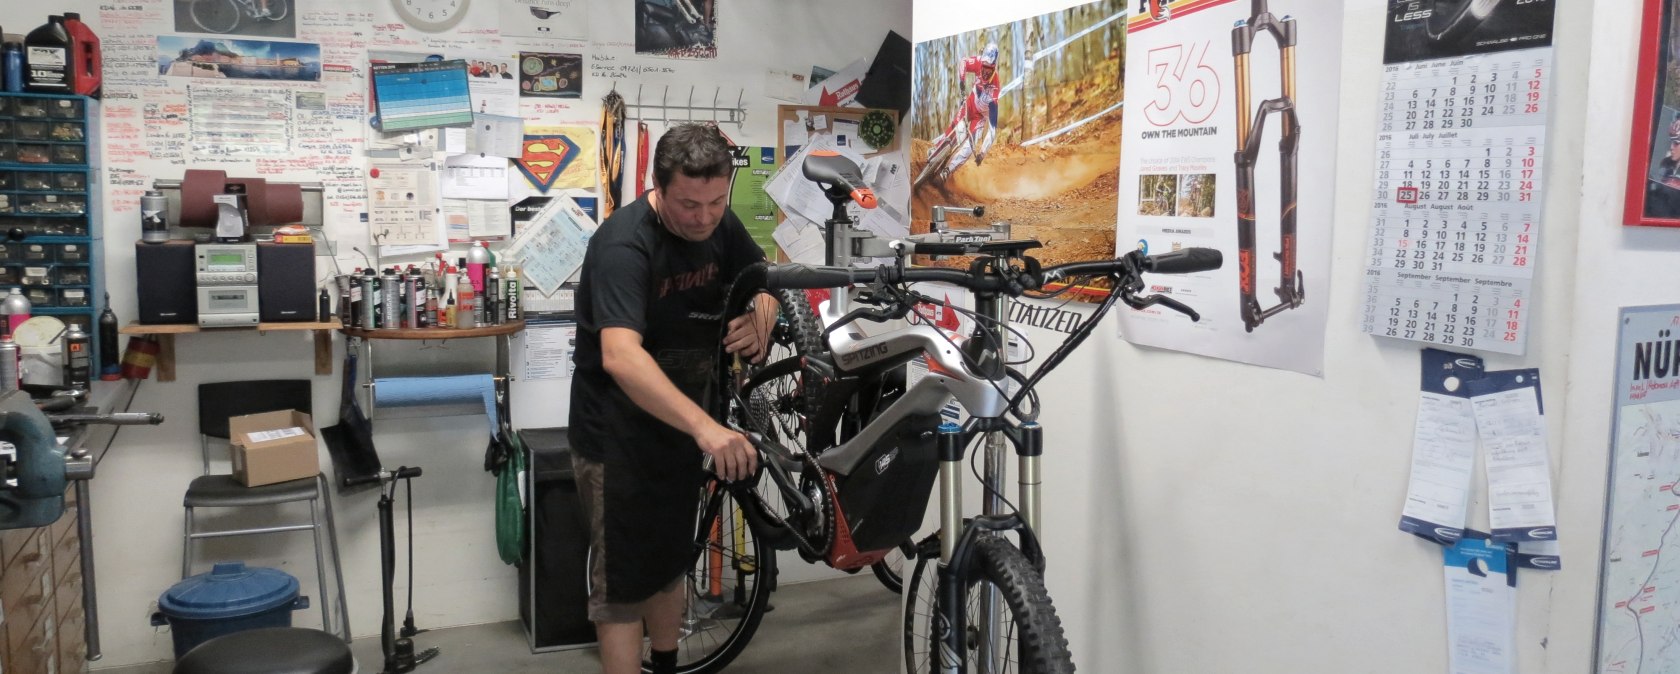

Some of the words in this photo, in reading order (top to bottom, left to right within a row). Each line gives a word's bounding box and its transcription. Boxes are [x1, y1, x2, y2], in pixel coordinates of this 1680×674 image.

[1394, 10, 1432, 22] LESS
[1144, 40, 1220, 126] 36
[1452, 77, 1456, 85] 1
[1471, 75, 1476, 83] 2
[1491, 73, 1497, 81] 3
[1535, 69, 1541, 78] 5
[1413, 90, 1418, 98] 6
[1432, 89, 1437, 97] 7
[1485, 84, 1496, 92] 10
[1528, 81, 1540, 89] 12
[1426, 99, 1435, 108] 14
[1464, 97, 1474, 105] 16
[1484, 95, 1495, 104] 17
[1527, 92, 1539, 101] 19
[1424, 110, 1434, 118] 21
[1442, 109, 1453, 117] 22
[1461, 108, 1473, 116] 23
[1481, 107, 1493, 115] 24
[1525, 104, 1538, 112] 26
[1460, 119, 1472, 127] 30
[1142, 131, 1160, 139] OWN
[1162, 130, 1176, 138] THE
[1177, 126, 1217, 137] MOUNTAIN
[1528, 147, 1534, 156] 3
[732, 158, 748, 166] ikes
[1522, 159, 1534, 167] 10
[1479, 171, 1489, 179] 15
[1521, 170, 1533, 178] 17
[1477, 182, 1489, 190] 22
[1520, 182, 1532, 190] 24
[1477, 192, 1488, 200] 29
[1520, 193, 1531, 201] 31
[1524, 224, 1530, 232] 7
[1476, 233, 1486, 241] 12
[1517, 235, 1529, 243] 14
[1474, 244, 1485, 252] 19
[1515, 246, 1527, 254] 21
[1452, 253, 1463, 261] 25
[1472, 254, 1483, 262] 26
[1513, 257, 1526, 266] 28
[1397, 272, 1431, 280] September
[1435, 275, 1470, 284] September
[1475, 278, 1512, 287] Septembre
[508, 282, 516, 319] Rivolta
[1514, 300, 1520, 308] 4
[1006, 300, 1082, 334] CIALIZED
[1472, 306, 1477, 314] 9
[1508, 310, 1518, 319] 11
[842, 342, 888, 366] SPITZING
